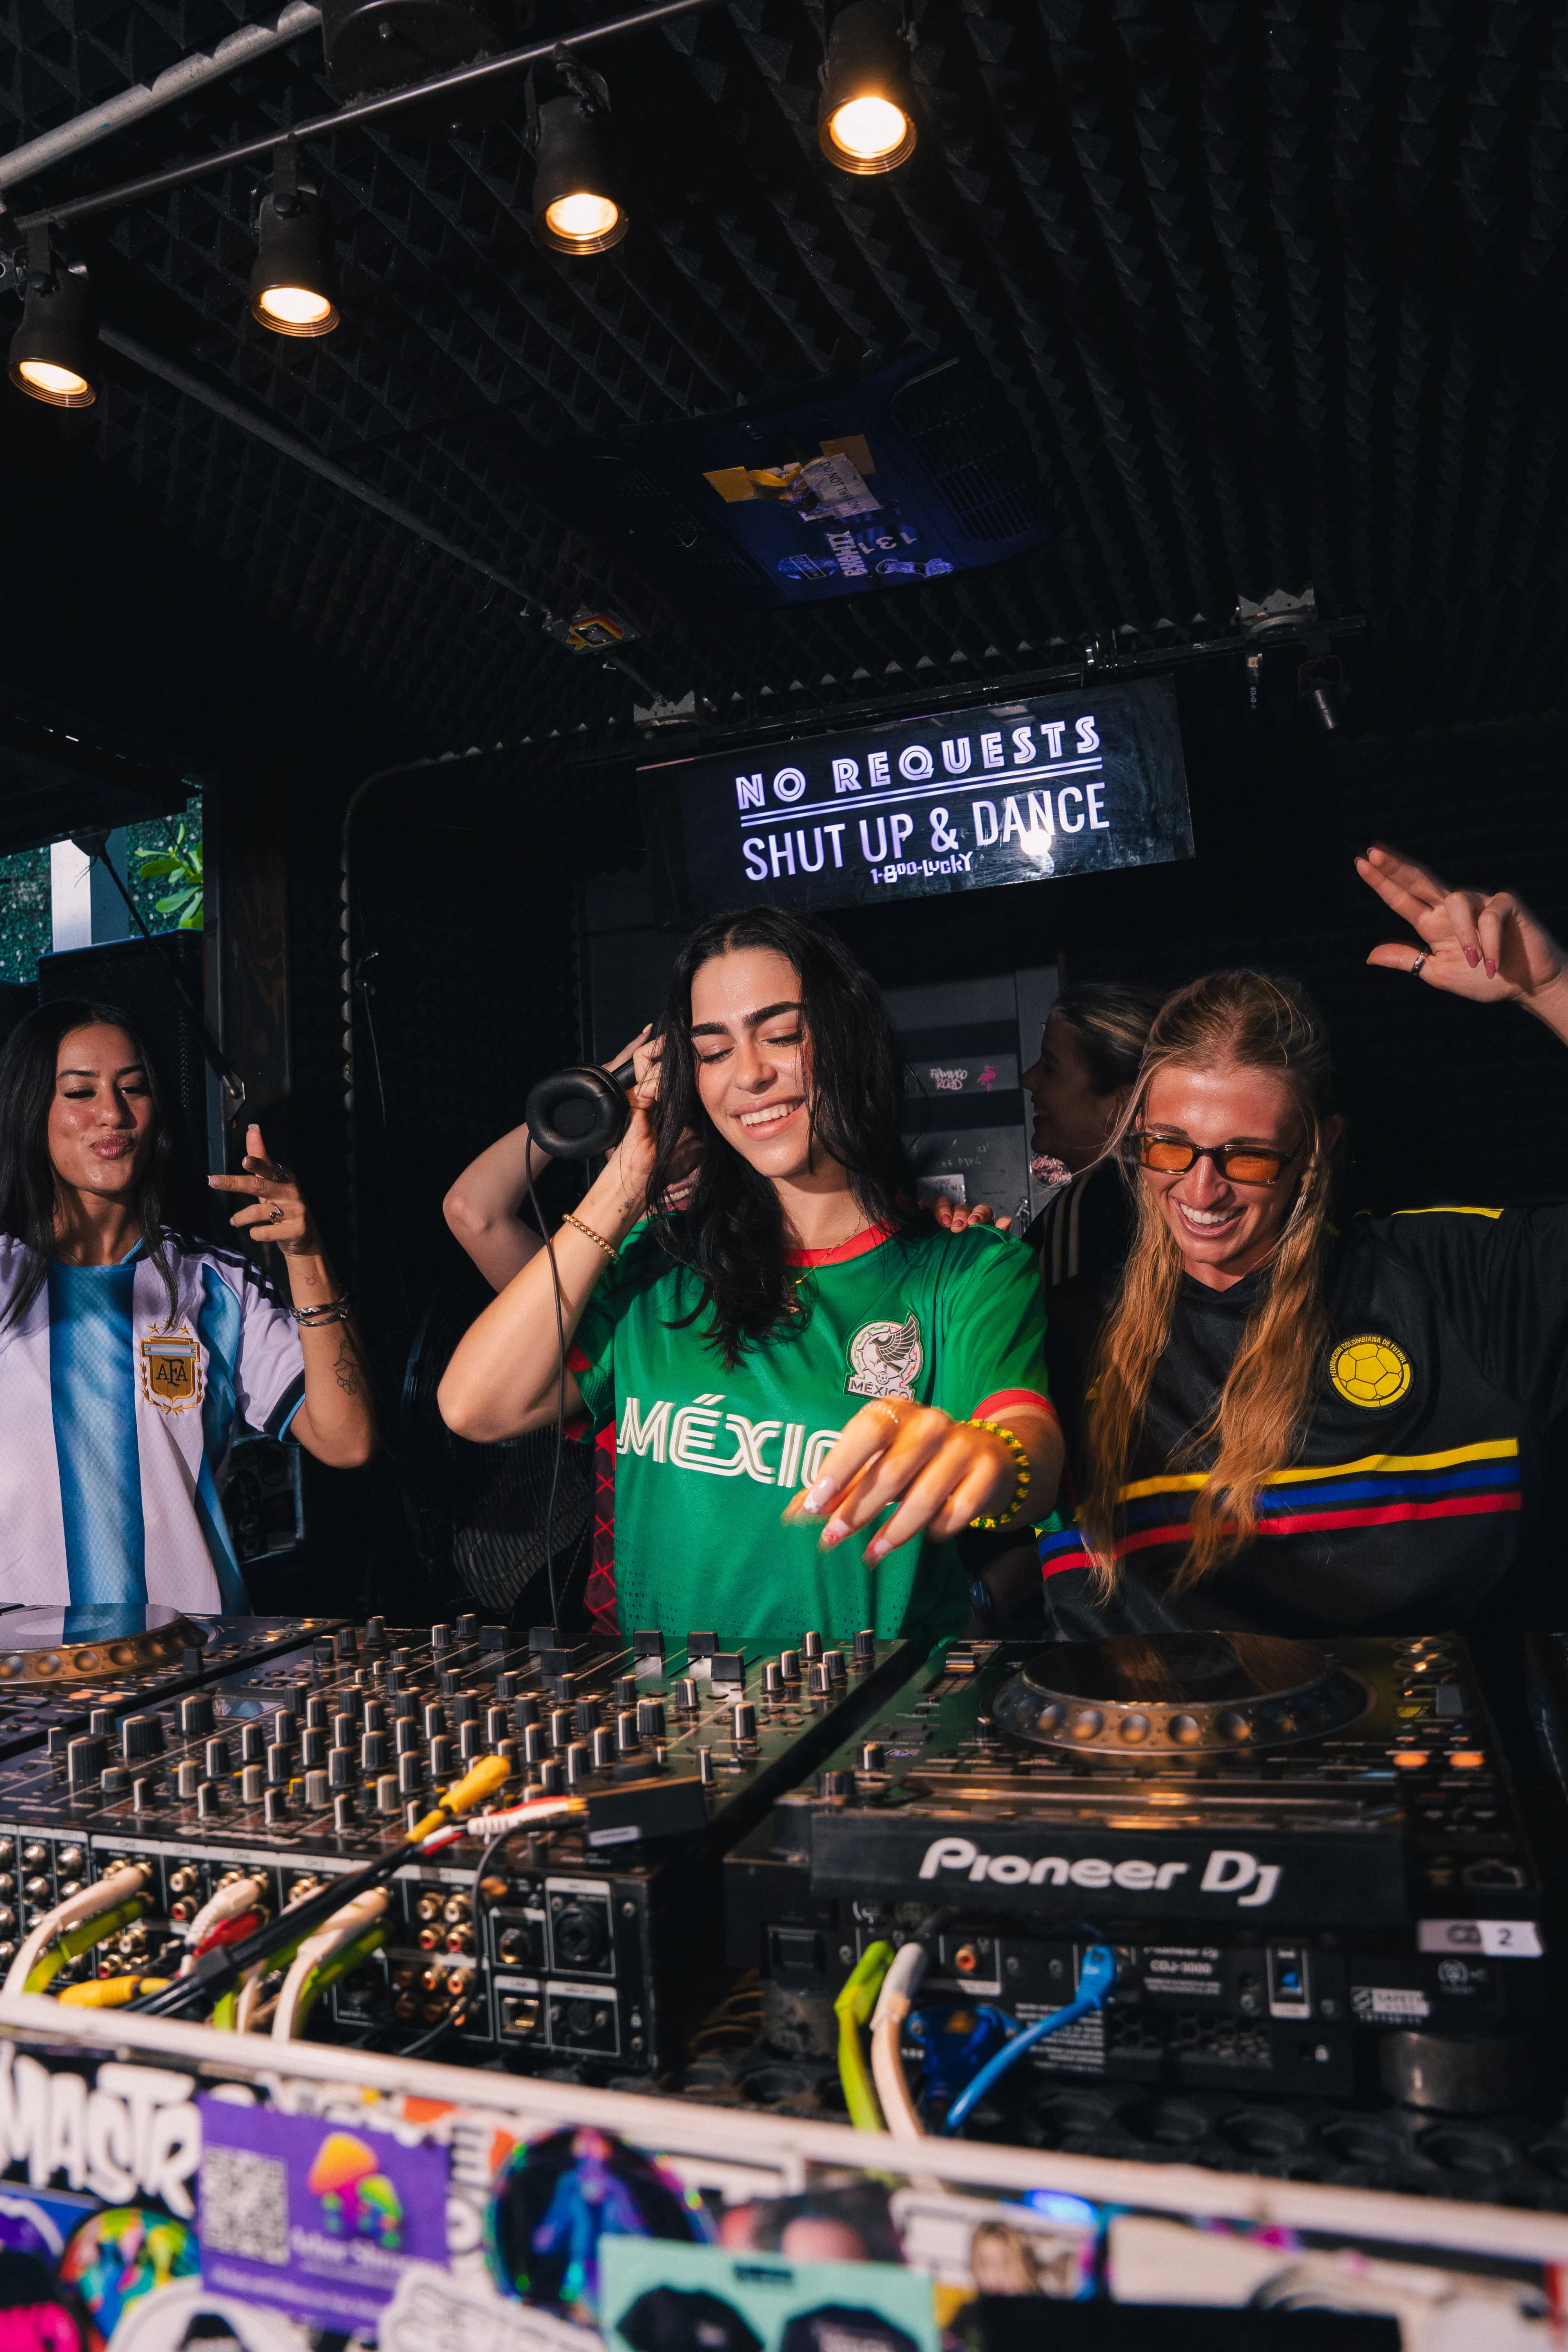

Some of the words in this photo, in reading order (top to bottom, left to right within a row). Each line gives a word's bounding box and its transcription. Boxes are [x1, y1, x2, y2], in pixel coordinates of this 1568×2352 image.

[827, 473, 844, 486] NOT
[735, 767, 806, 810] NO
[831, 715, 1101, 793] REQUESTS
[743, 823, 847, 881] SHUT
[860, 813, 914, 863] UP
[930, 806, 959, 853] &
[972, 782, 1110, 847] DANCE
[156, 1356, 189, 1387] AFA
[1330, 1346, 1344, 1376] FEDERACION
[1342, 1336, 1381, 1350] COLOMBIANA
[1382, 1339, 1390, 1347] DE
[1390, 1344, 1407, 1364] FUTBOL
[850, 1380, 910, 1401] MÉXICO
[616, 1393, 843, 1490] MÉXIC
[918, 1836, 1188, 1891] Pioneer
[1200, 1849, 1284, 1908] DJ
[1497, 1927, 1512, 1947] 2
